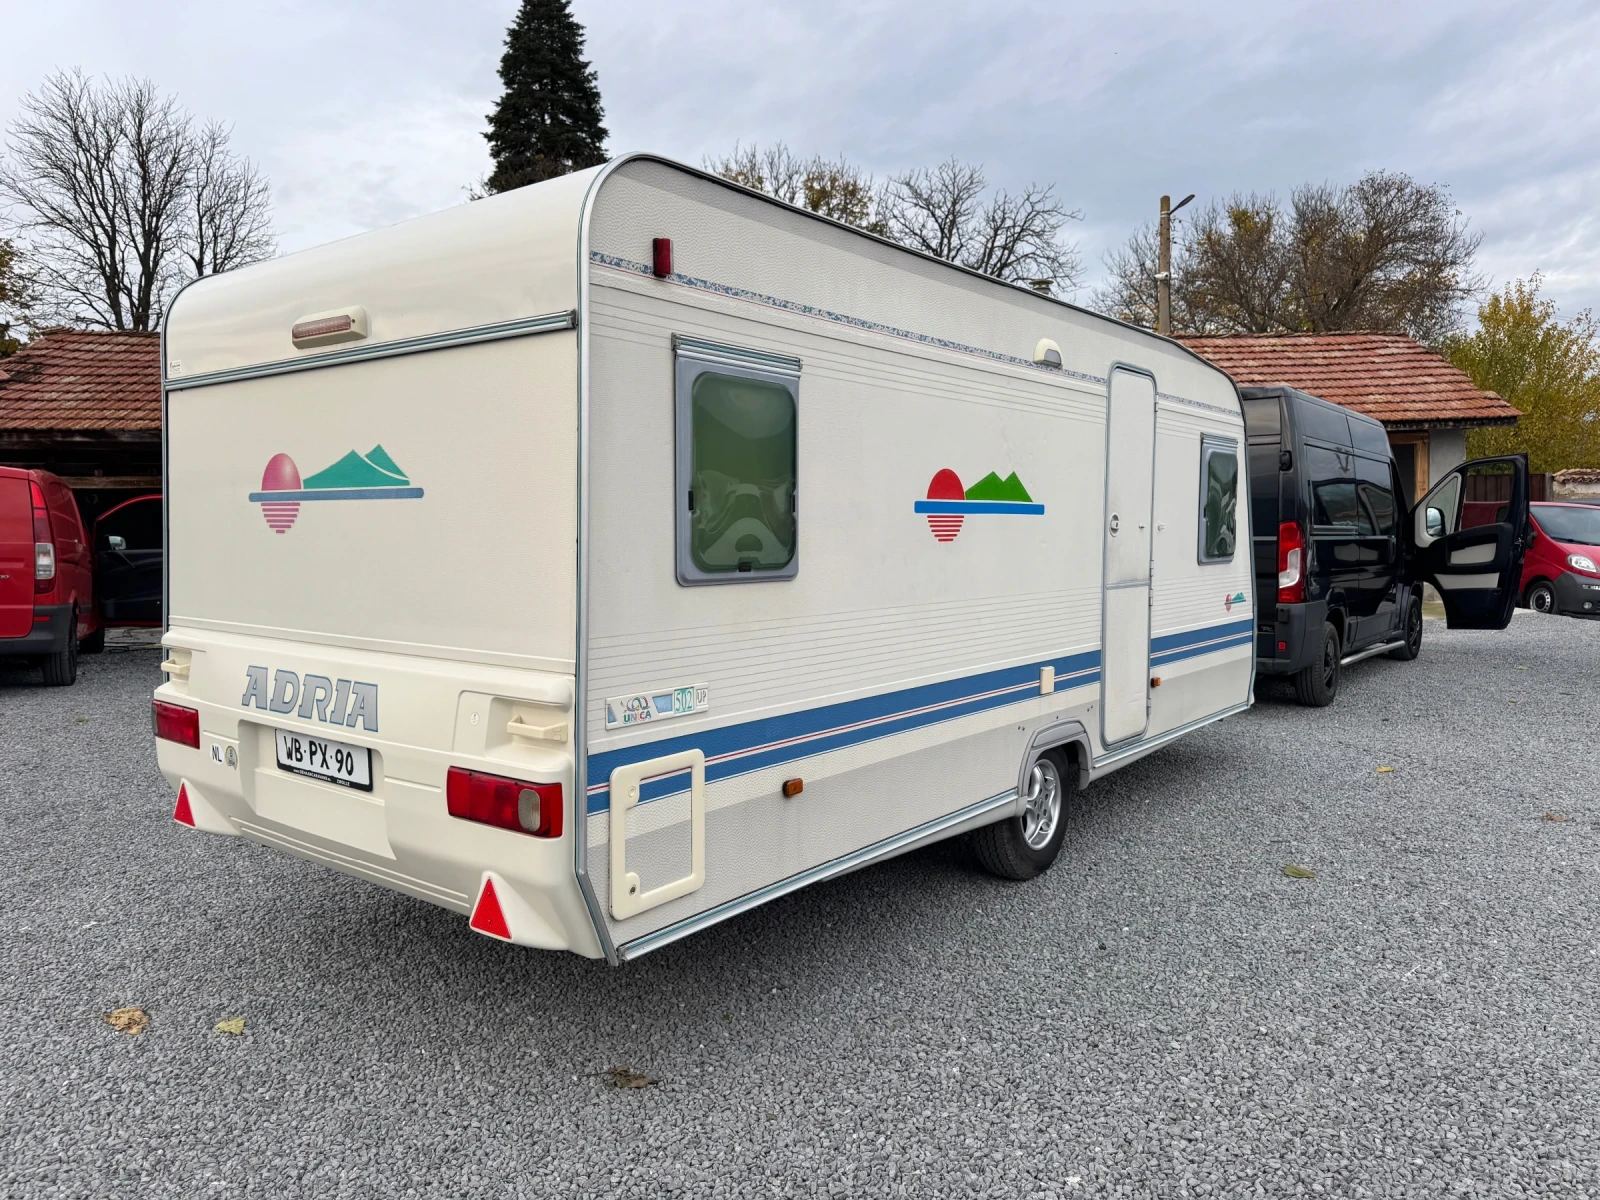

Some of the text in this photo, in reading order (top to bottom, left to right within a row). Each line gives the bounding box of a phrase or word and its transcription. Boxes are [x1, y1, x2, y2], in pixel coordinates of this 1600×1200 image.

[242, 665, 378, 732] ADRIA
[623, 689, 706, 724] UNICA 502 UP
[212, 745, 222, 762] NL
